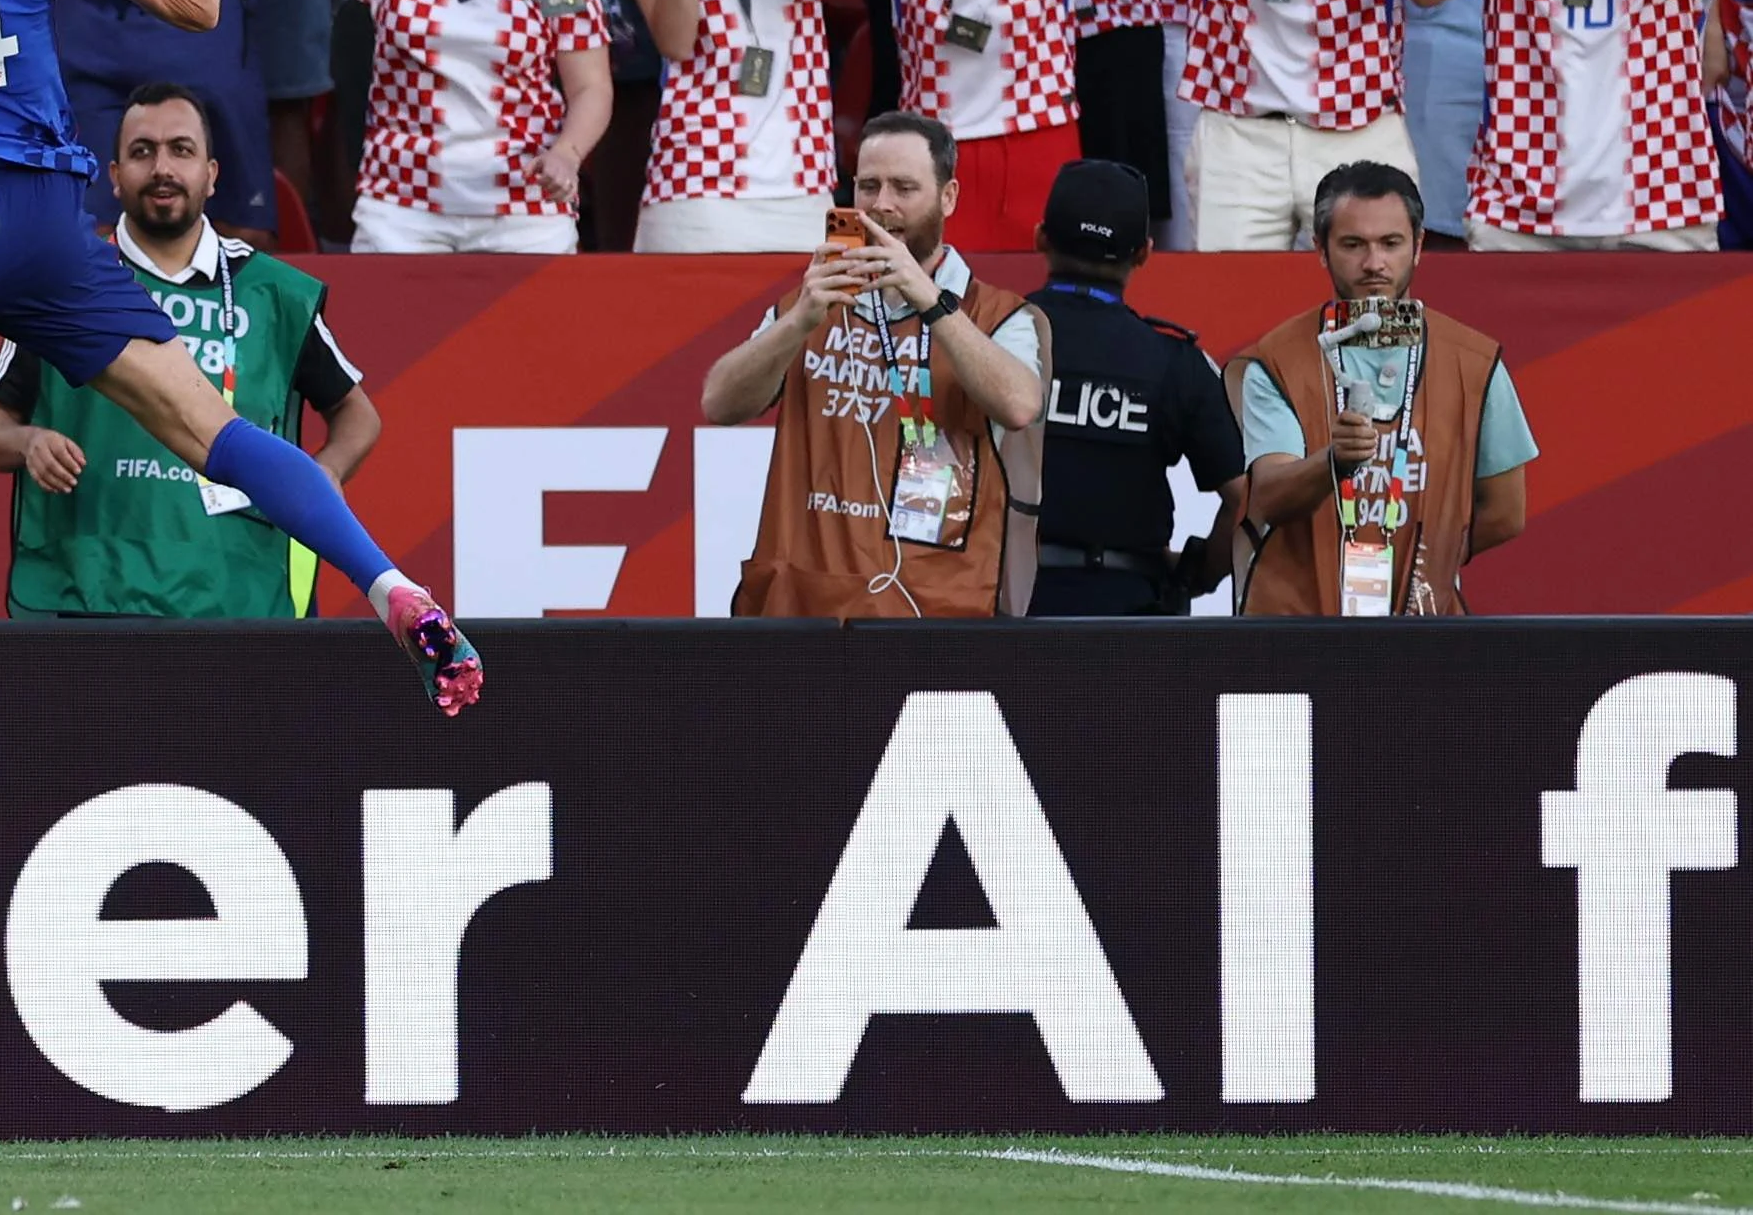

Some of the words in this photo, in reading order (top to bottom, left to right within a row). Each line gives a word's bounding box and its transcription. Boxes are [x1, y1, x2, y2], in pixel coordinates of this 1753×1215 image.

[1080, 222, 1114, 238] POLICE
[150, 290, 250, 339] OTO
[824, 325, 919, 361] MEDA
[822, 389, 891, 424] 3757
[1047, 378, 1149, 431] LICE
[116, 459, 197, 482] FIFA.co
[740, 690, 1316, 1105] AI
